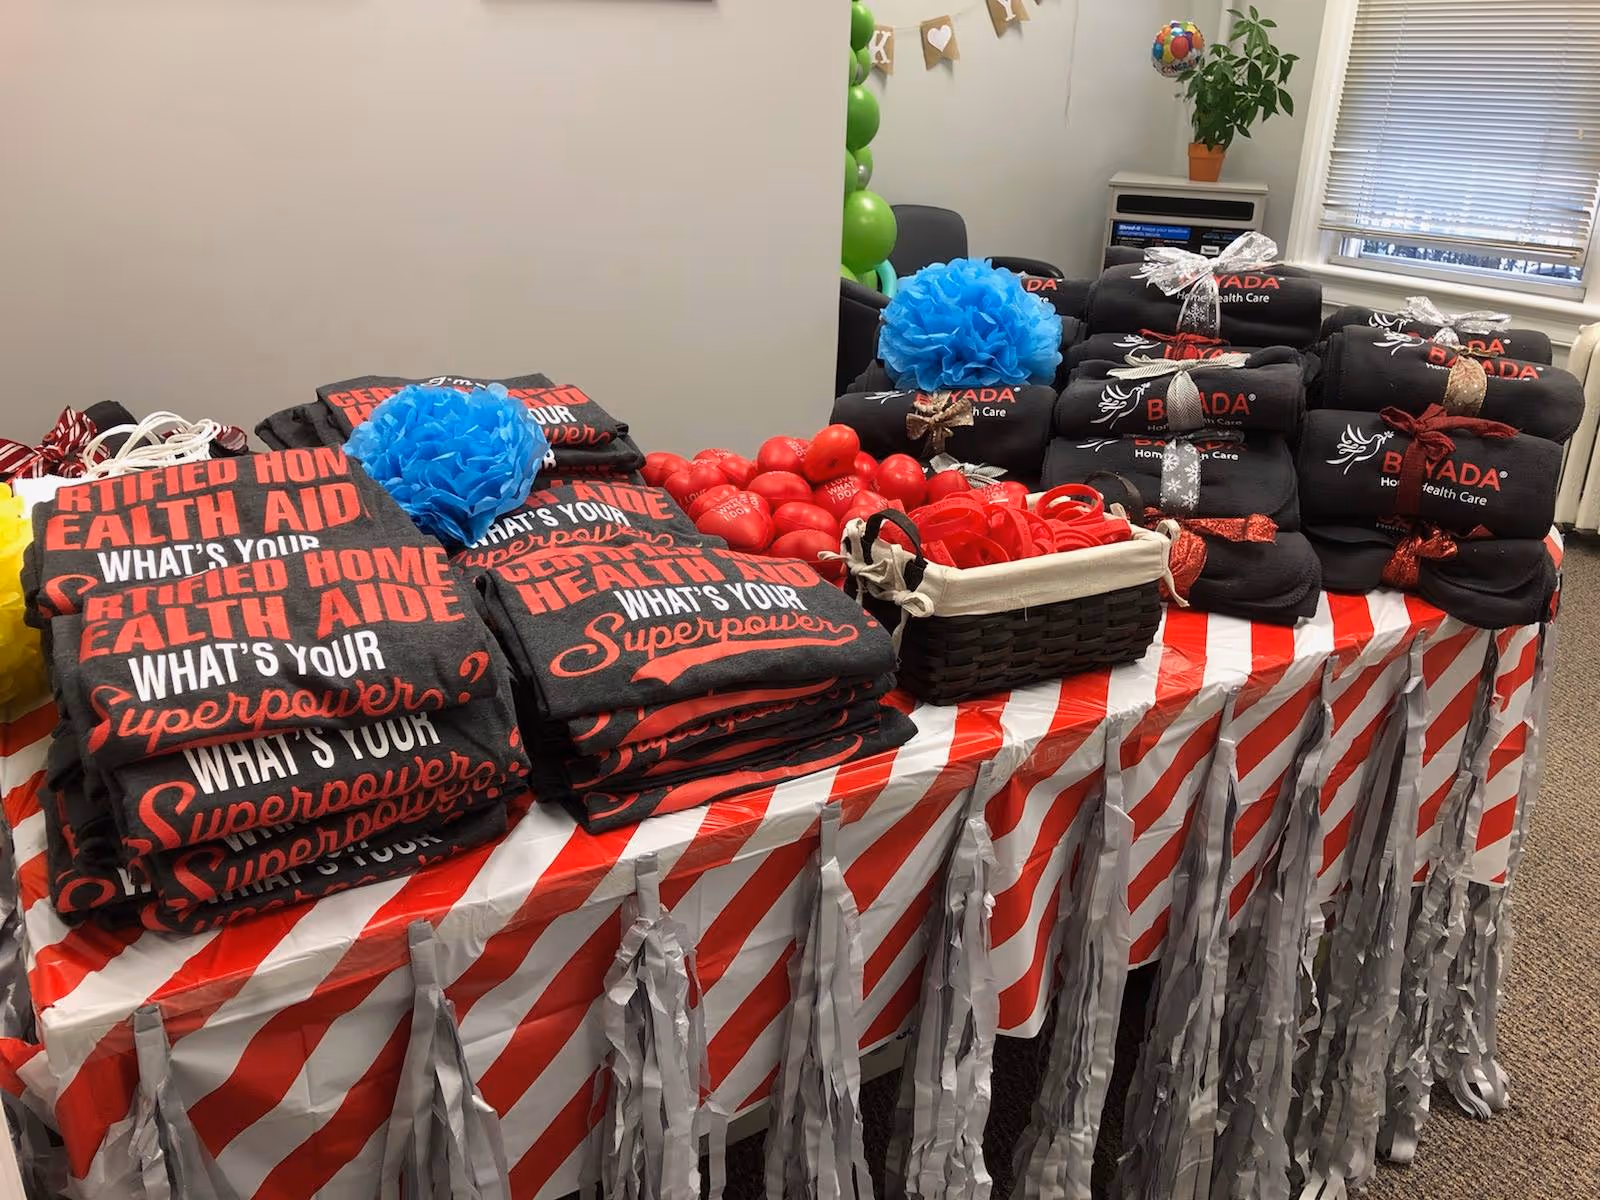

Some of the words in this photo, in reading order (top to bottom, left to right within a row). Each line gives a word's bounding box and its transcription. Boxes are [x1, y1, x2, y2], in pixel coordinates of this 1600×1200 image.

[1245, 293, 1270, 303] Care
[982, 407, 1007, 417] Care
[1211, 451, 1239, 461] Care
[57, 459, 238, 512] RTIFIED
[827, 481, 855, 496] WHAT
[1459, 490, 1488, 506] Care
[46, 490, 240, 551] EALTH
[264, 482, 361, 534] AID
[556, 502, 632, 528] YOUR
[86, 558, 289, 622] RTIFIED
[304, 545, 455, 588] HOME
[514, 555, 727, 616] HEALTH
[613, 582, 731, 621] WHAT'S
[724, 581, 809, 612] YOUR
[79, 596, 292, 664] EALTH
[315, 581, 466, 641] AIDE
[128, 641, 280, 703] WHAT'S
[284, 629, 387, 679] YOUR
